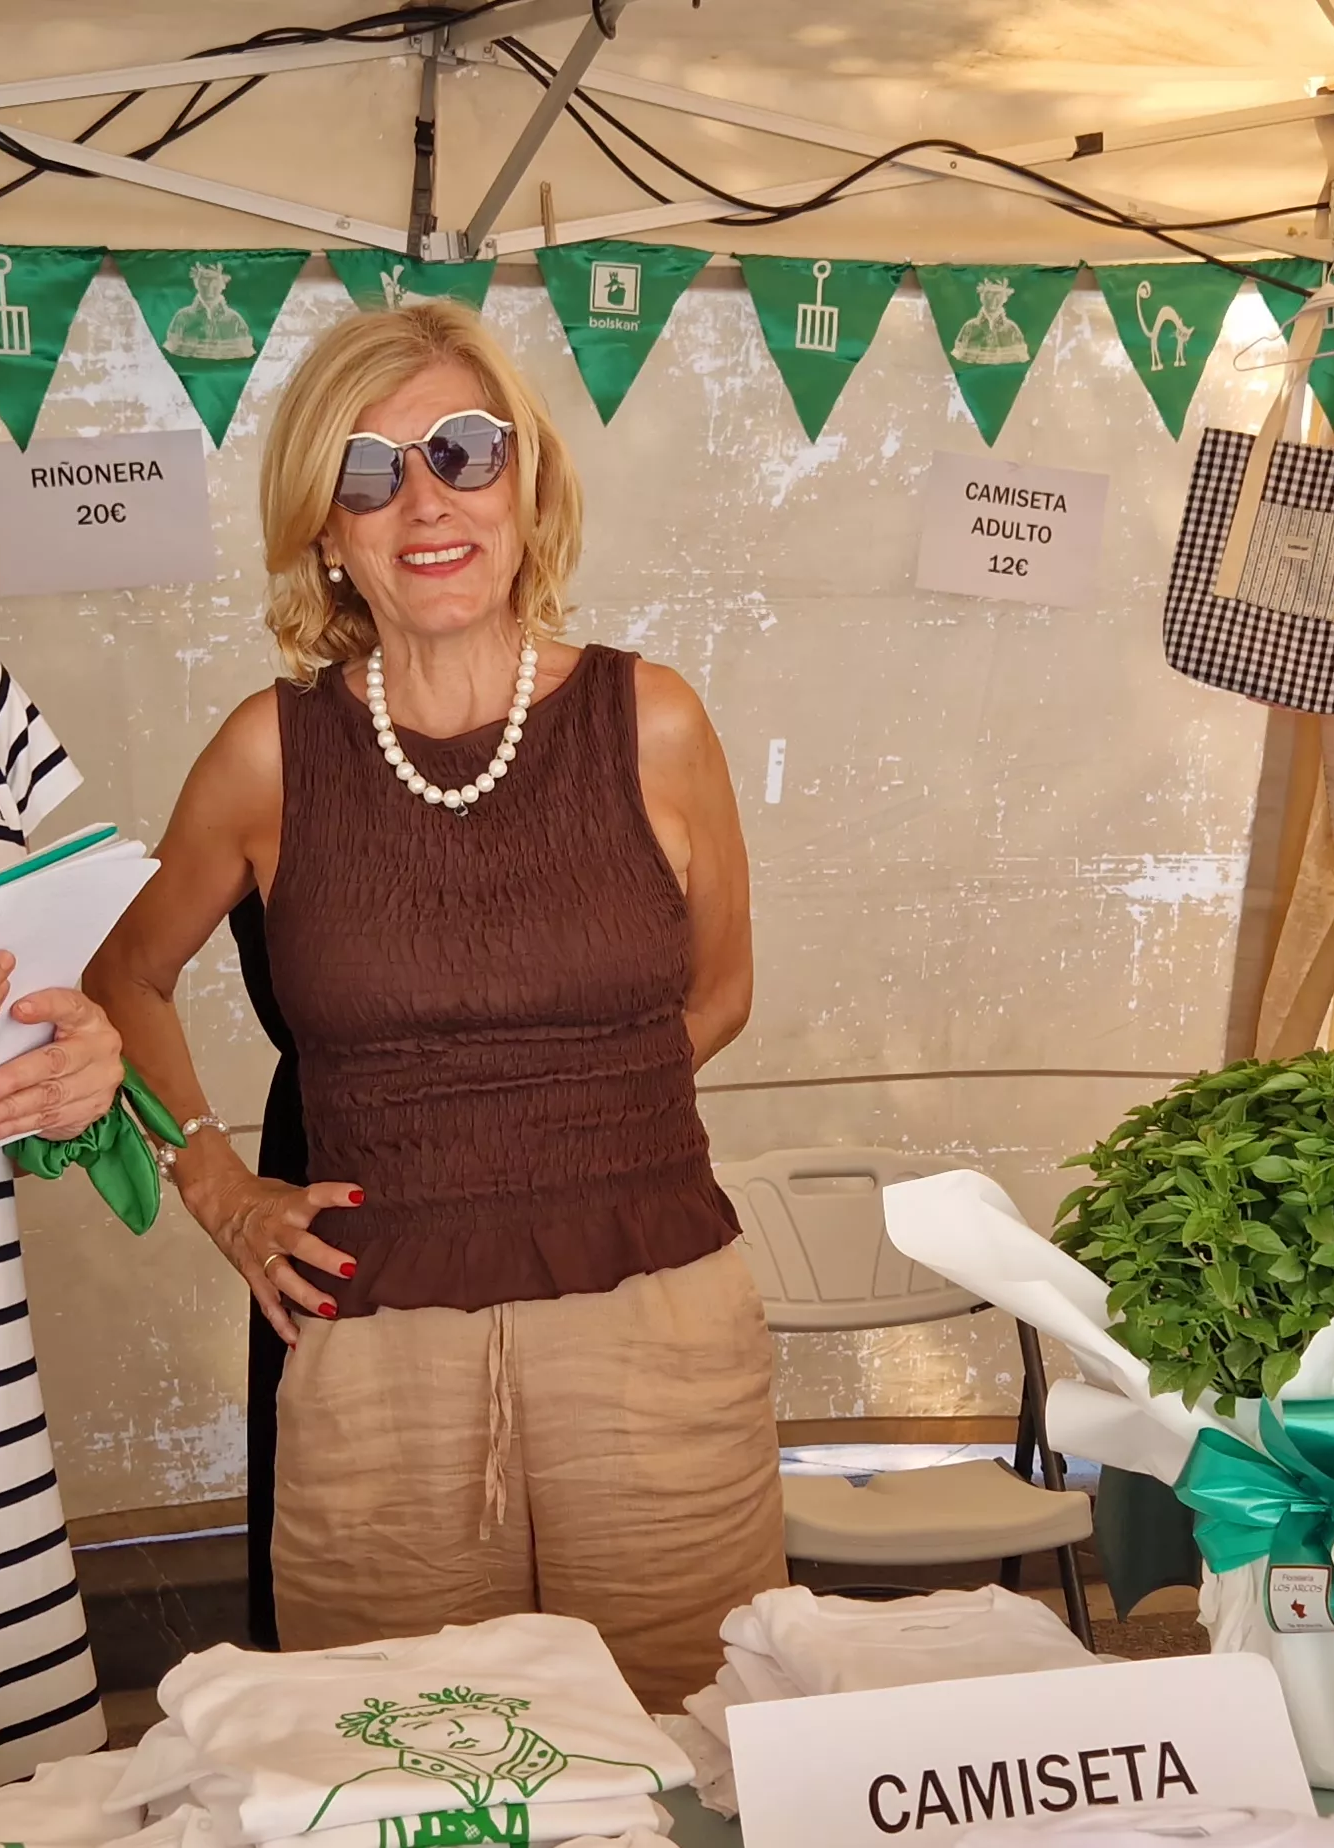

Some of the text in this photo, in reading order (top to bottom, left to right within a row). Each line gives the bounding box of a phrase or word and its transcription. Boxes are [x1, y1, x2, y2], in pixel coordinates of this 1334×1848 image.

[30, 461, 164, 489] RIÑONERA
[965, 481, 1067, 513] CAMISETA
[76, 502, 127, 526] 20€
[971, 516, 1052, 544] ADULTO
[987, 554, 1029, 577] 12€
[1273, 1584, 1290, 1592] LOS
[868, 1741, 1199, 1834] CAMISETA
